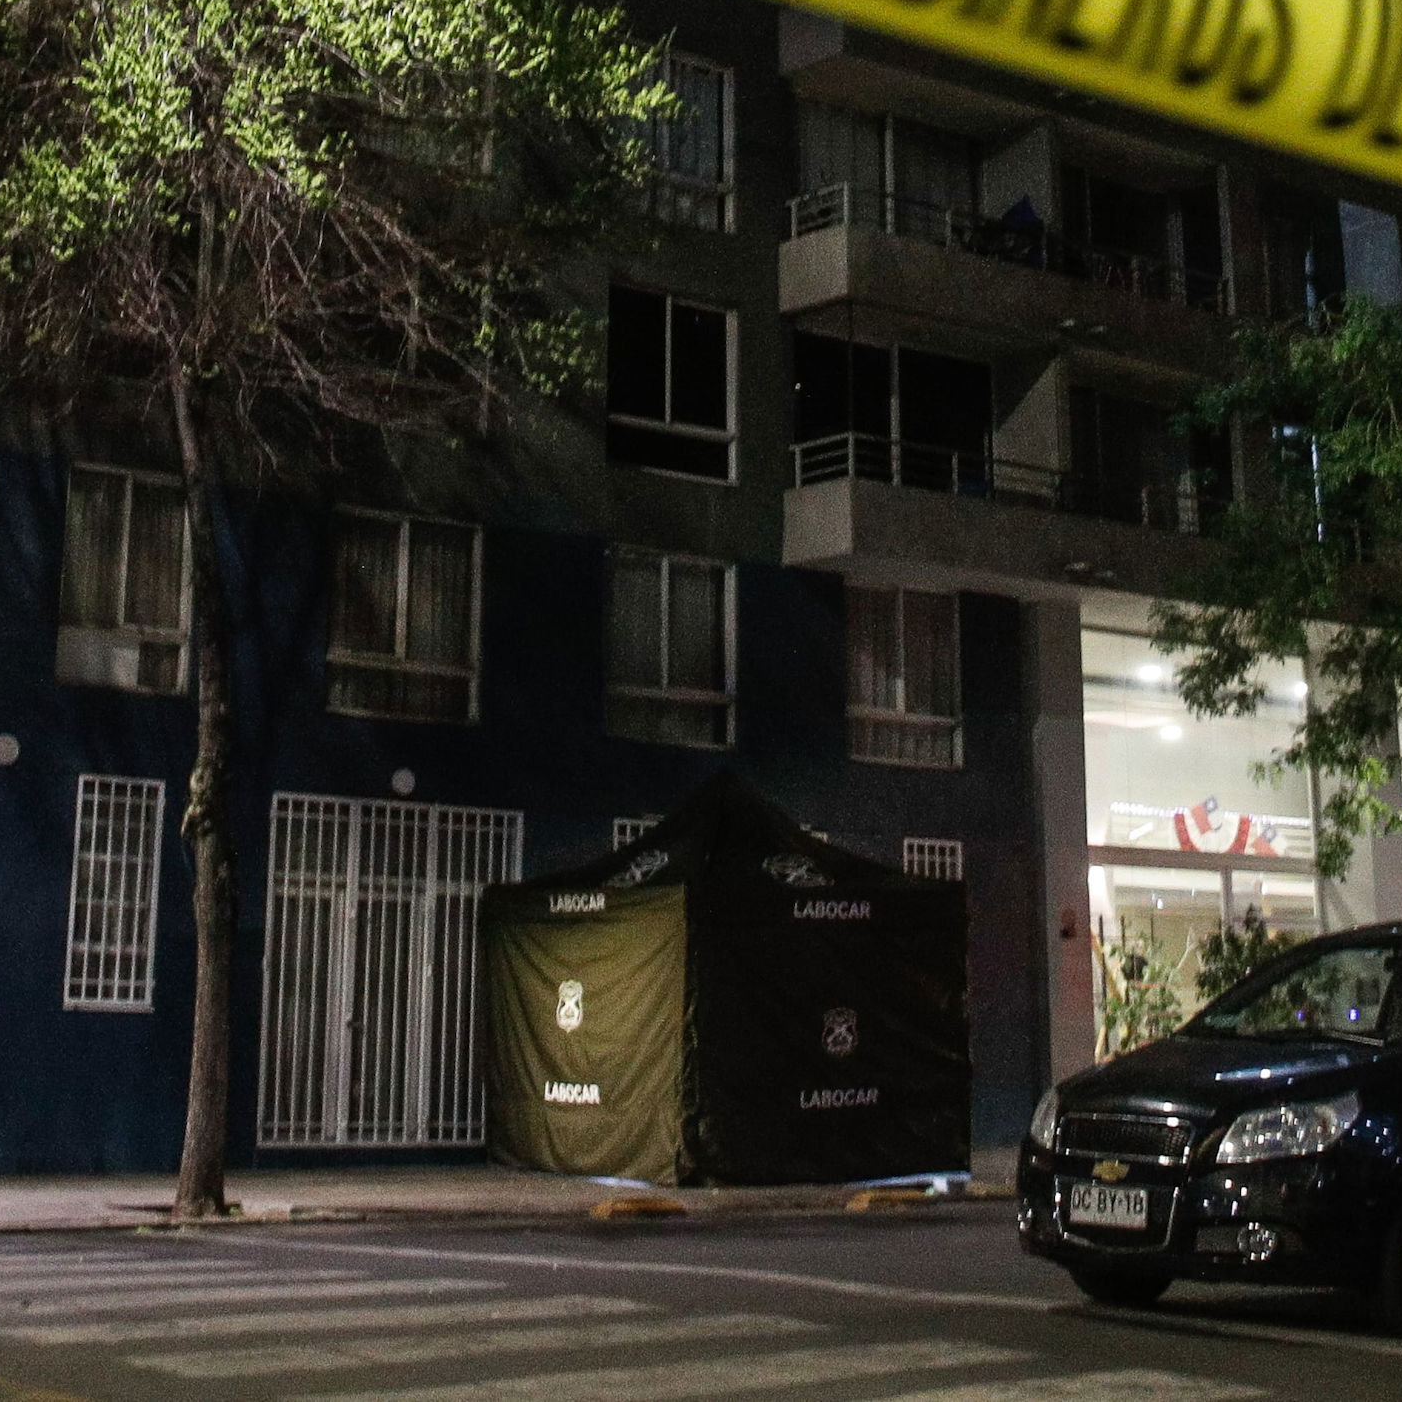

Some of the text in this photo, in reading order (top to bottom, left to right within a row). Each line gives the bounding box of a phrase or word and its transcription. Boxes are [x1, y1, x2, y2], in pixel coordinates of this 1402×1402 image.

[549, 892, 606, 913] LABOCAR
[793, 899, 871, 920] LABOCAR
[544, 1080, 600, 1105] LABOCAR
[799, 1087, 879, 1110] LABOCAR
